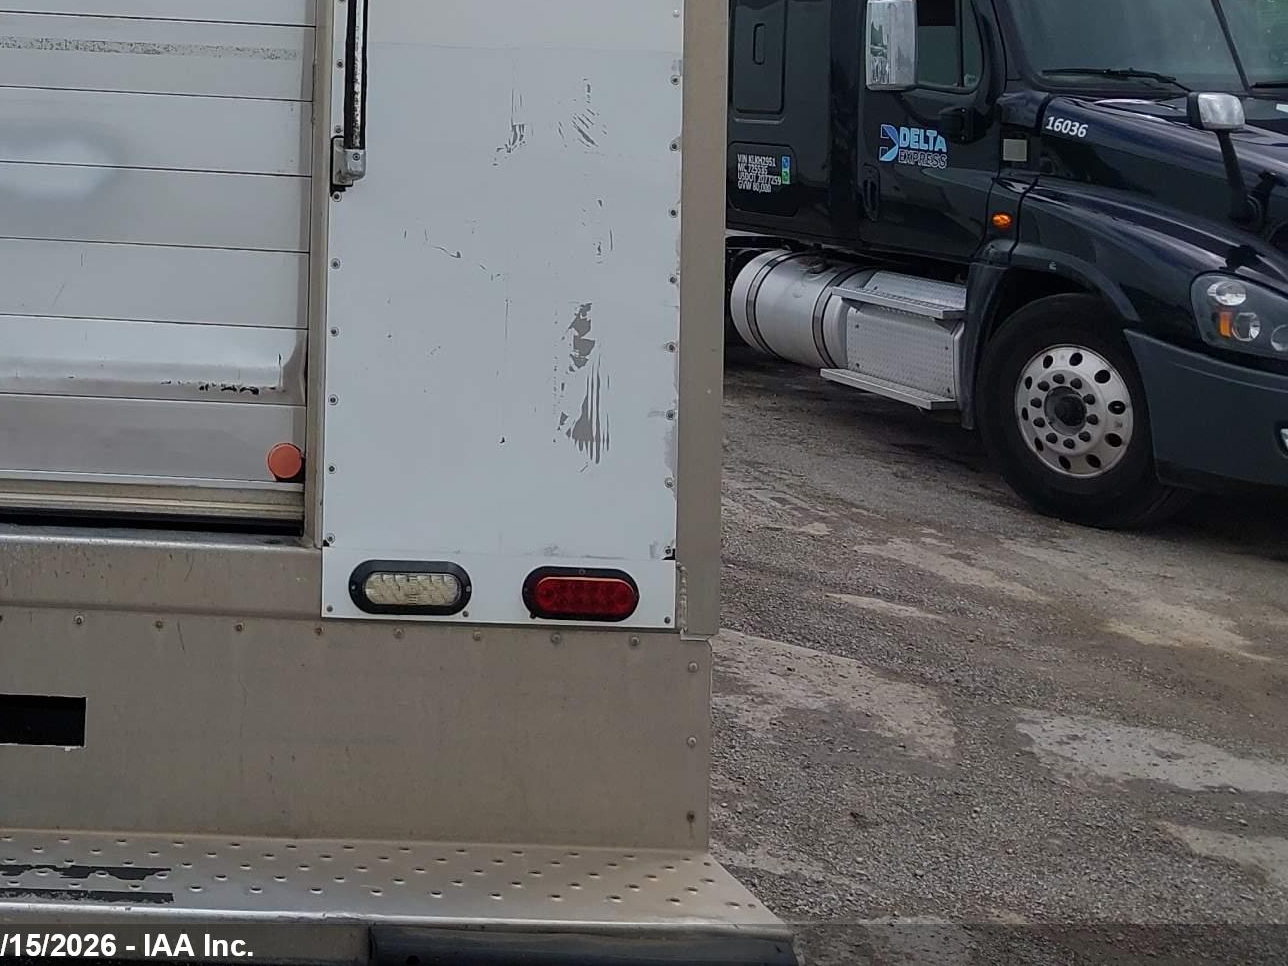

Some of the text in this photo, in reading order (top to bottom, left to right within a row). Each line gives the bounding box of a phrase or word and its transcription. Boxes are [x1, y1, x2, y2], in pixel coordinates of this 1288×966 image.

[1045, 116, 1089, 138] 16036
[899, 127, 947, 152] DELTA
[737, 153, 748, 163] VIN
[898, 149, 948, 169] EXPRESS
[737, 162, 747, 172] MC
[737, 170, 756, 182] USDOT
[737, 180, 752, 190] GVW
